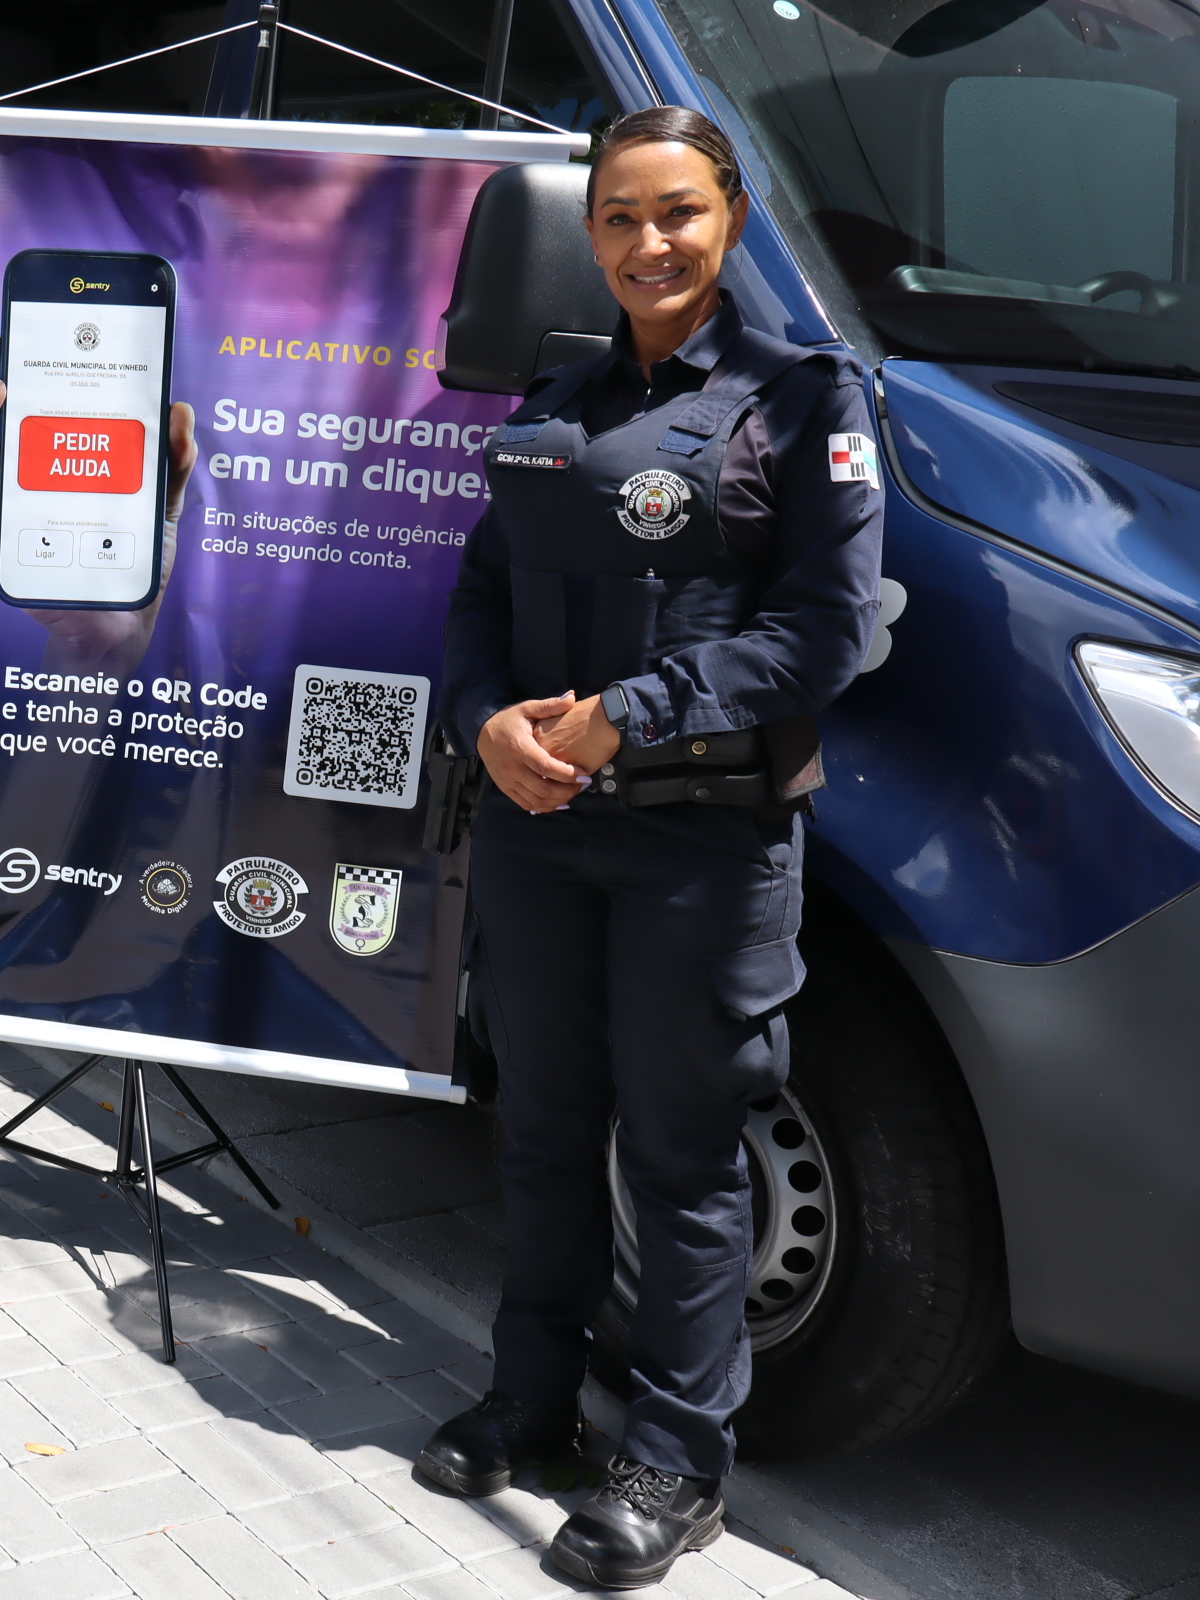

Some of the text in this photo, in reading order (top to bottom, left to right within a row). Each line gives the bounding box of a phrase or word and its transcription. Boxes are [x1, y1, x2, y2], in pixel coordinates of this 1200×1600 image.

[85, 282, 110, 292] sentry
[218, 336, 392, 366] APLICATIVO
[23, 360, 51, 368] GUARDA
[52, 361, 69, 369] CIVIL
[71, 362, 107, 370] MUNICIPAL
[119, 364, 148, 372] VINHEDO
[213, 399, 498, 455] Sua segurança
[53, 432, 111, 452] PEDIR
[50, 458, 111, 478] AJUDA
[209, 453, 271, 481] em
[285, 459, 348, 488] um
[497, 454, 514, 462] GCM
[522, 456, 530, 464] CL
[531, 457, 553, 466] KATIA
[629, 471, 685, 491] PATRULHEIRO
[627, 485, 645, 509] GUARDA
[204, 507, 467, 547] Em situações de urgência
[621, 513, 655, 538] PROTETOR
[664, 518, 685, 537] AMIGO
[35, 550, 55, 559] Ligar
[97, 552, 116, 560] Chat
[201, 536, 411, 569] cada segundo conta.
[4, 666, 268, 710] Escaneie o QR Code
[2, 701, 244, 741] e tenha a proteção
[0, 731, 224, 768] que você merece.
[45, 863, 122, 896] sentry
[142, 860, 175, 878] verdadeira
[176, 864, 193, 888] criadora
[226, 860, 300, 886] PATRULHEIRO
[140, 895, 188, 914] Muralha Digital
[229, 874, 248, 901] GUARDA
[270, 874, 293, 909] MUNICIPAL
[219, 903, 262, 934] PROTETOR
[273, 915, 301, 934] AMIGO
[245, 915, 272, 924] VINHEDO
